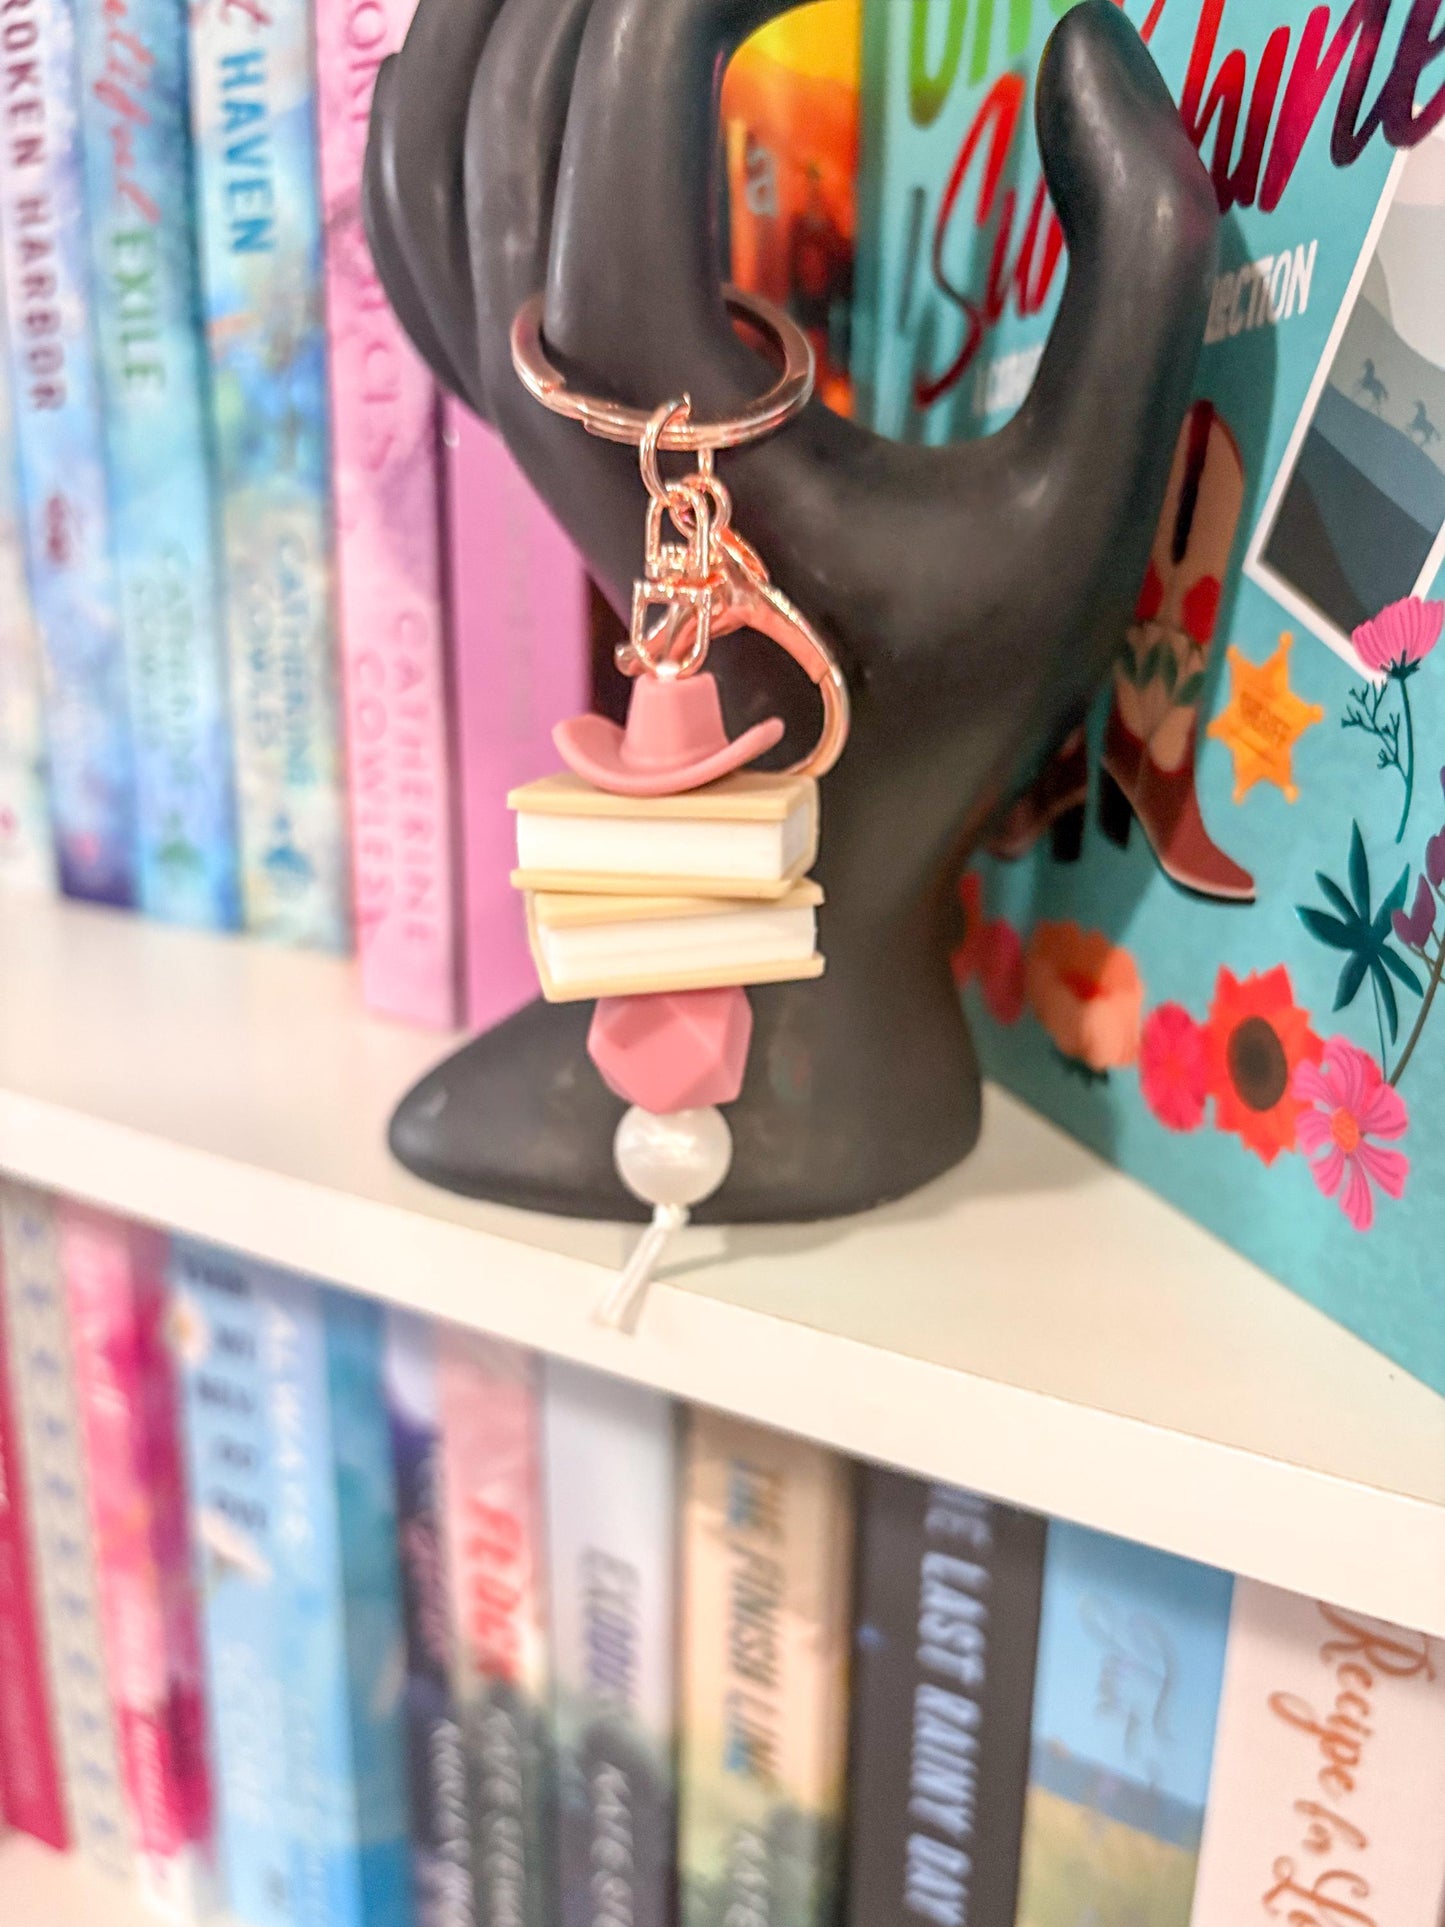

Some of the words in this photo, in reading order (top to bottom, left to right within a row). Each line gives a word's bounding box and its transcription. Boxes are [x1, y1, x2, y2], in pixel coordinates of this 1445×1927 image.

[0, 0, 45, 169] OKEN
[219, 50, 276, 254] HAVEN
[14, 197, 67, 412] HARBOR
[112, 228, 167, 388] EXILE
[351, 650, 394, 901] COWLES
[395, 610, 436, 942] CATHERINE
[727, 1460, 787, 1545] THE
[730, 1548, 786, 1687] FINISH
[917, 1551, 990, 1683] LAST
[723, 1690, 781, 1784] LINE
[908, 1683, 982, 1839] RAINY
[1267, 1600, 1436, 1797] Recipe
[905, 1833, 972, 1927] DAY
